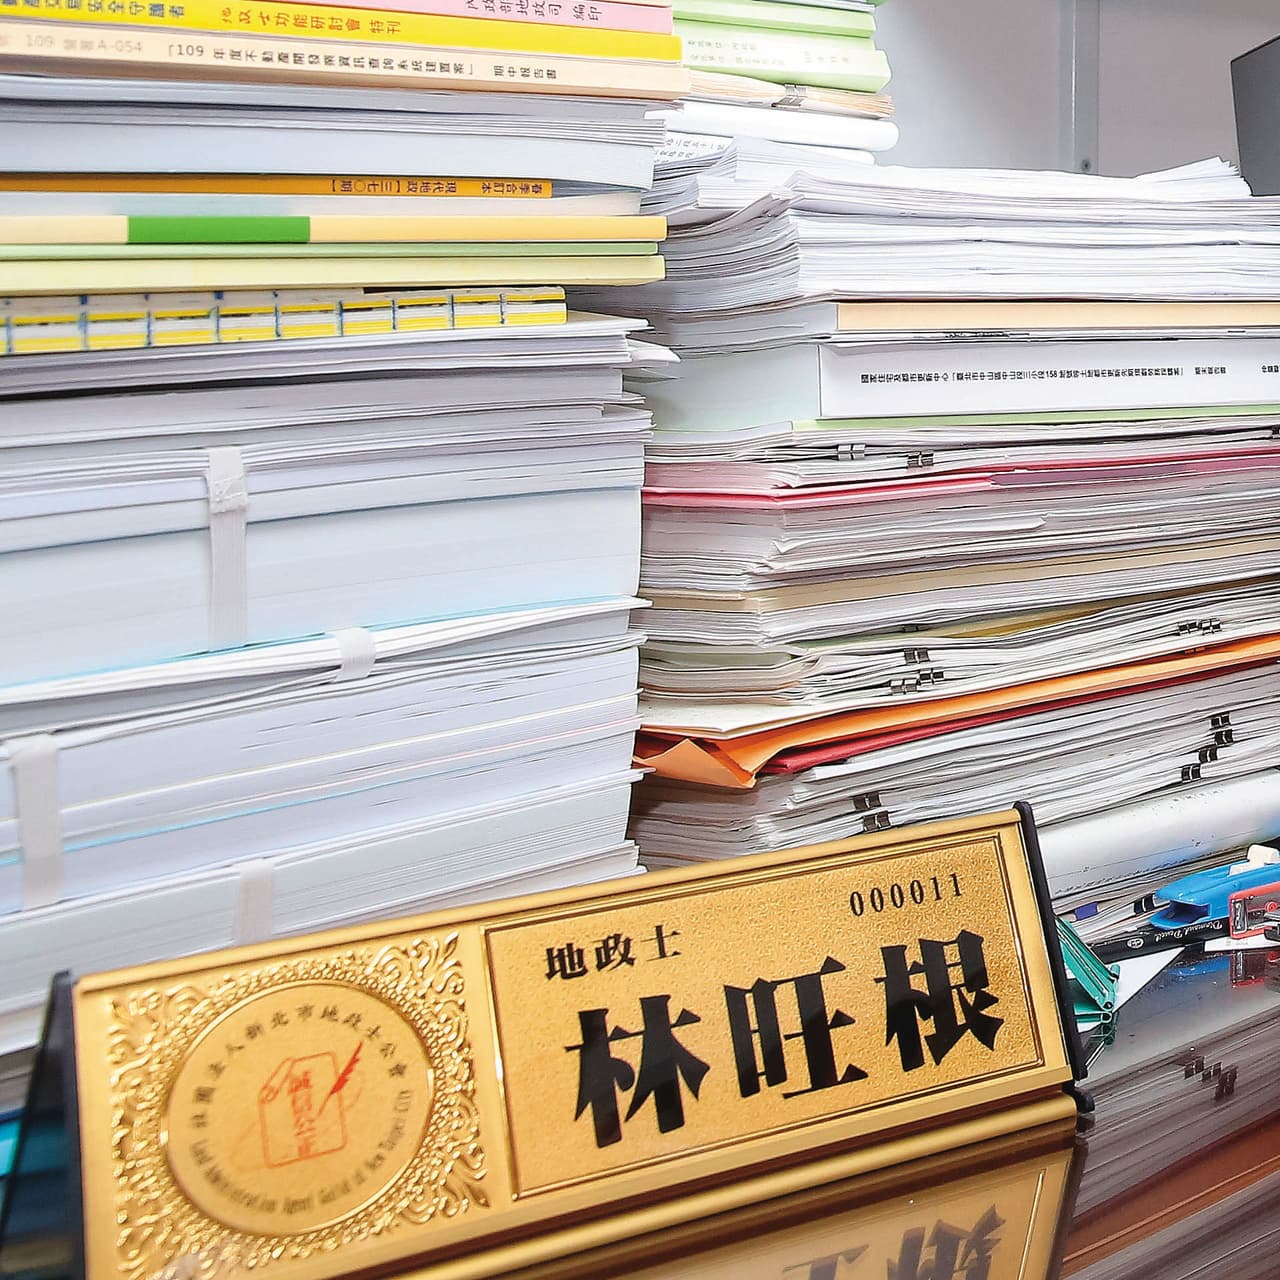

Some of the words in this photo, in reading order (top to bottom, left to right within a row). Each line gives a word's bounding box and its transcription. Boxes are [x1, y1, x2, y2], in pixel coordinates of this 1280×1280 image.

[221, 6, 362, 32] 地政士功能研討會
[369, 19, 400, 35] 特刊
[572, 3, 602, 22] 編印
[493, 64, 557, 80] 期中報告書
[481, 180, 543, 195] 春季合訂本
[849, 872, 963, 917] 000011
[545, 924, 682, 981] 地政士
[564, 929, 1004, 1149] 林旺根
